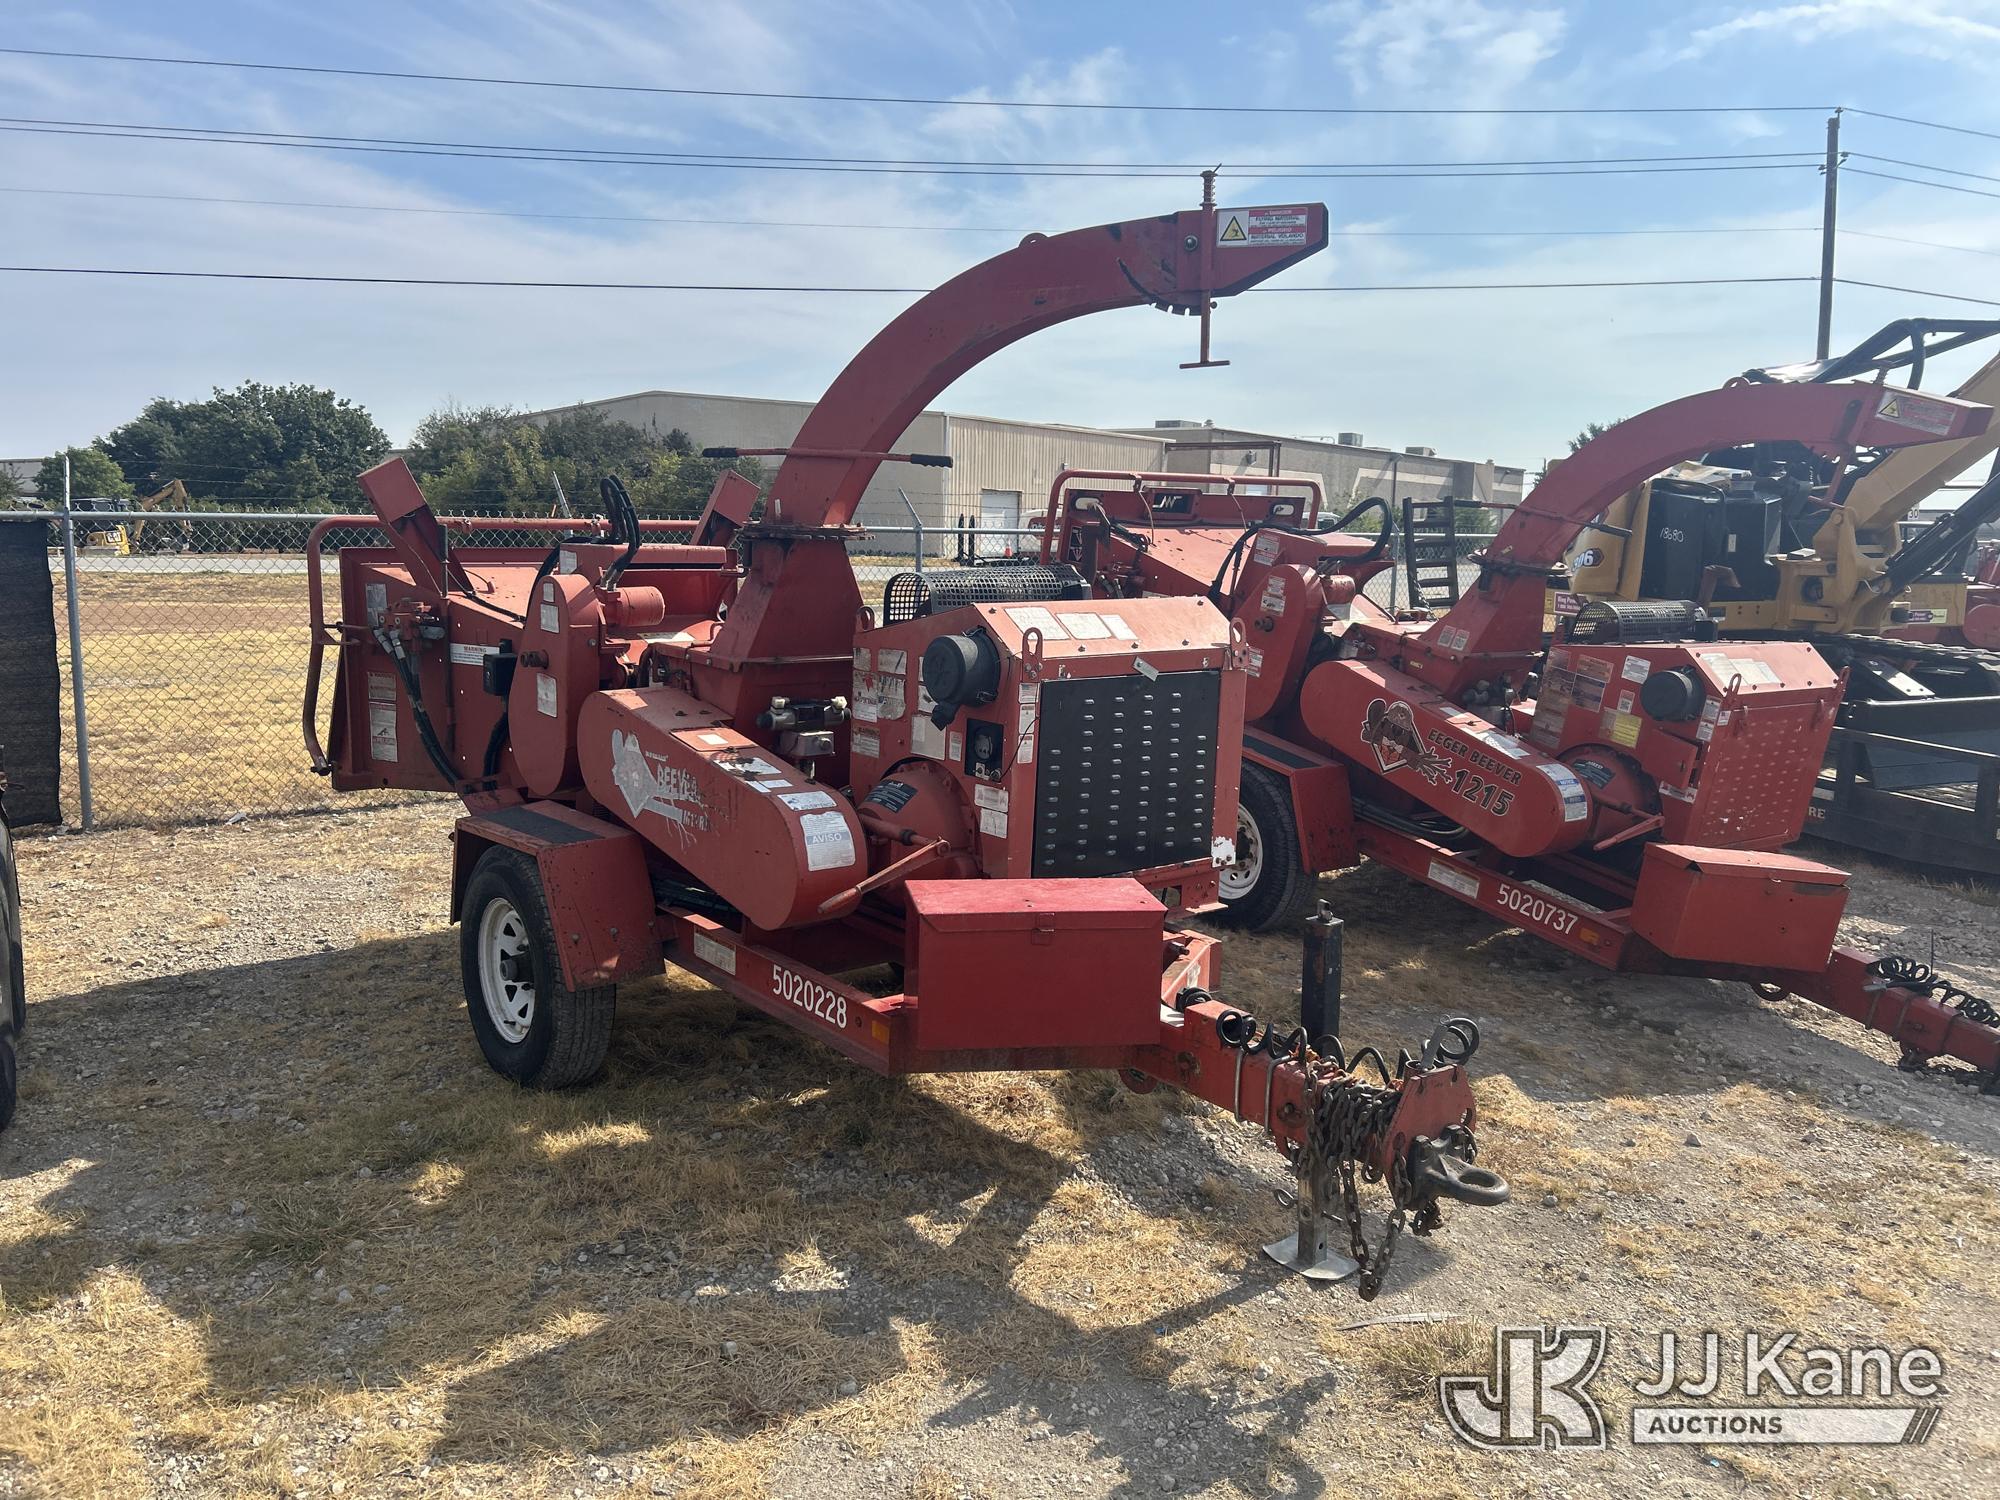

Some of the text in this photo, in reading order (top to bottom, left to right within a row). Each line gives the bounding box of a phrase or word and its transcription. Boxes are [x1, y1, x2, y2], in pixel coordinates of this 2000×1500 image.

[1427, 728, 1469, 757] EEGER
[1470, 750, 1523, 786] BEEVER
[1451, 768, 1515, 816] 1215
[812, 832, 842, 844] AVISO
[1497, 883, 1579, 935] 5020737
[772, 964, 847, 1028] 5020228
